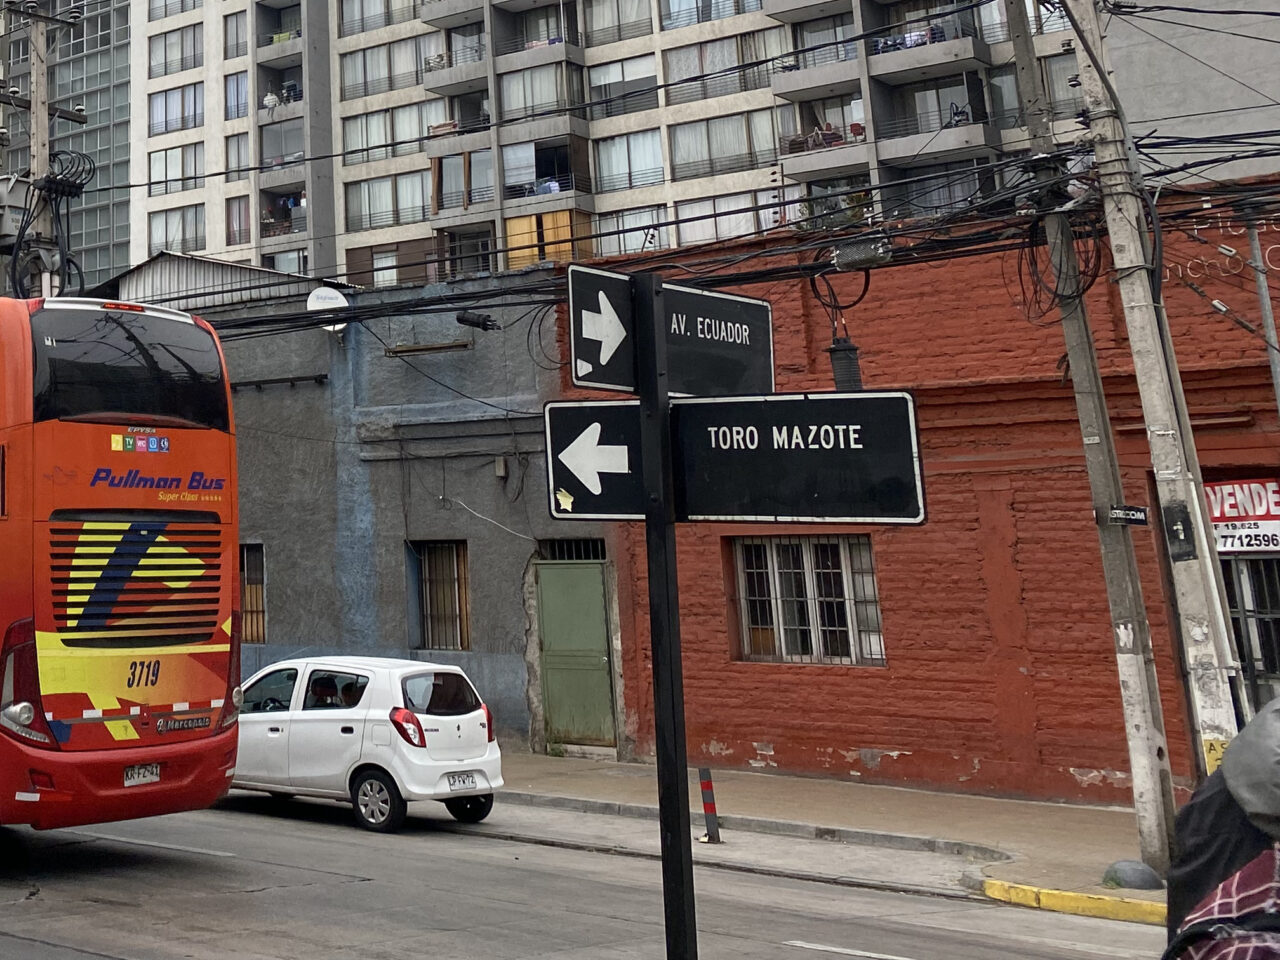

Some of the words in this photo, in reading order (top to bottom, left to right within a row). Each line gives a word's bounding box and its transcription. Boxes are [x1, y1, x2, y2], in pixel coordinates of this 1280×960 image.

[671, 313, 691, 337] AV.
[697, 317, 750, 346] ECUADOR
[708, 425, 759, 450] TORO
[772, 424, 864, 450] MAZOTE
[90, 468, 182, 490] Pullman
[187, 471, 226, 490] Bus
[158, 491, 179, 502] Super
[180, 491, 199, 501] Class
[1205, 482, 1280, 517] VENDE
[127, 659, 161, 689] 3719
